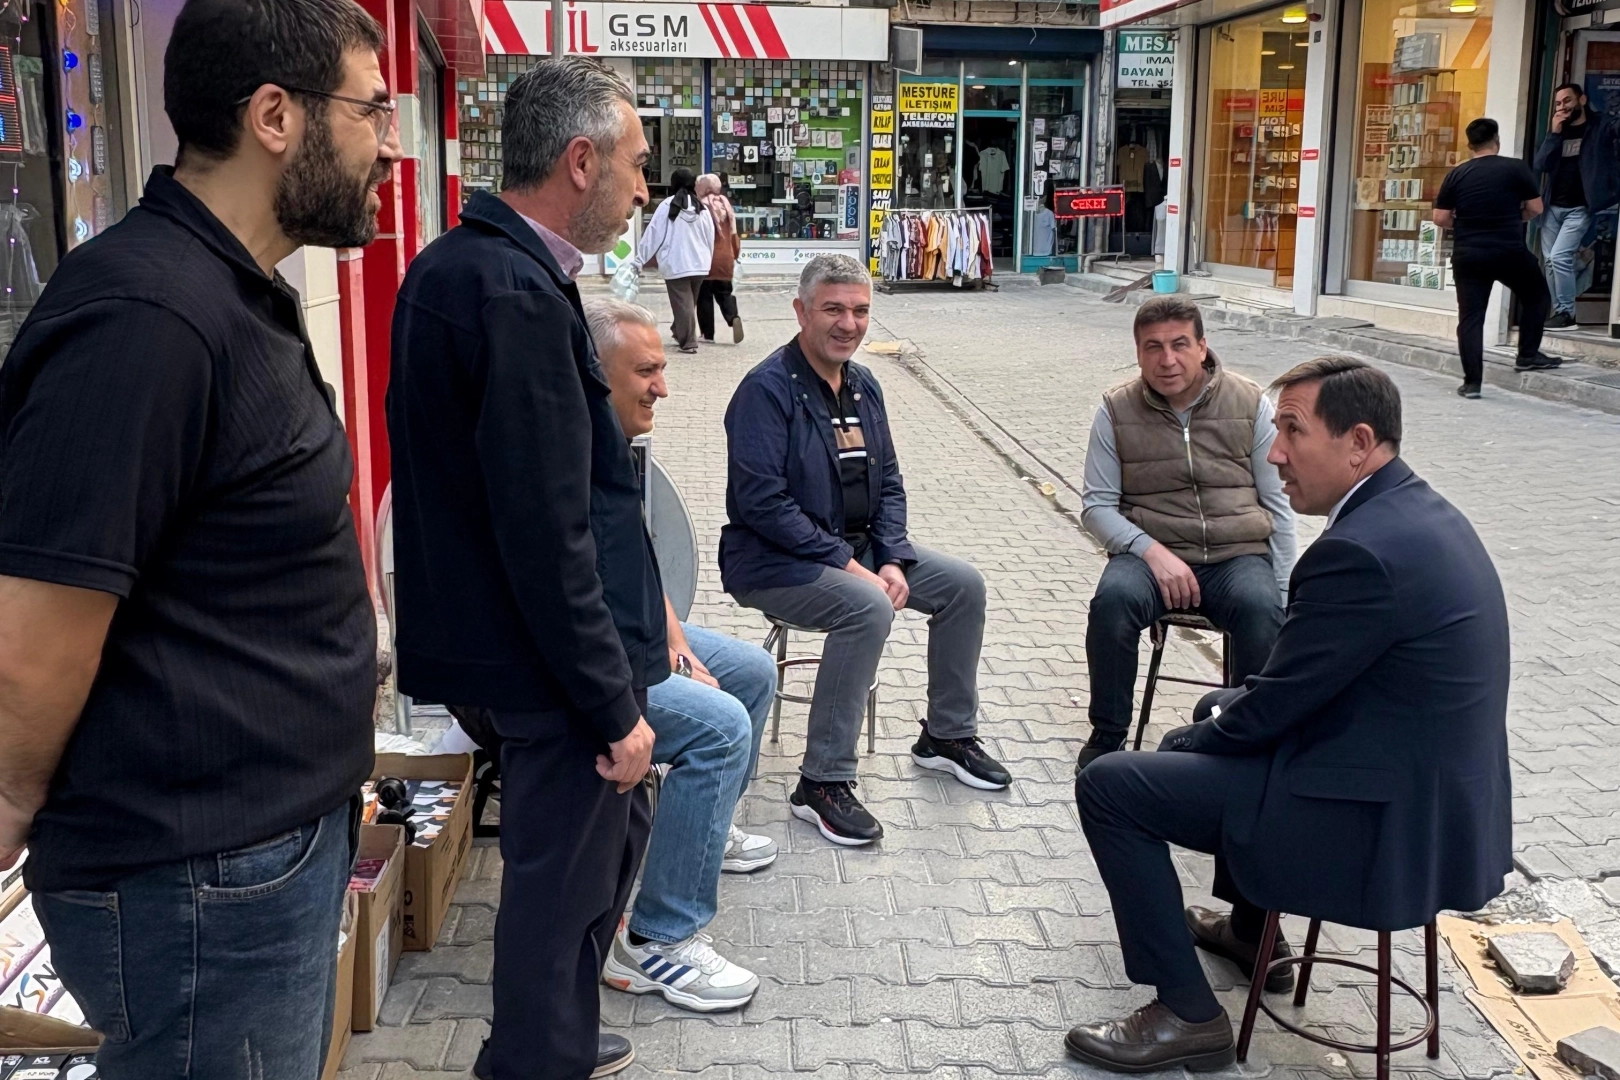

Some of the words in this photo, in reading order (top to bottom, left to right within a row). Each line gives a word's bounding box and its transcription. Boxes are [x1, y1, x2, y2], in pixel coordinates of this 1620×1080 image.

[608, 14, 688, 37] GSM
[1121, 67, 1163, 76] BAYAN
[902, 86, 956, 99] MESTURE
[902, 112, 955, 122] TELEFON
